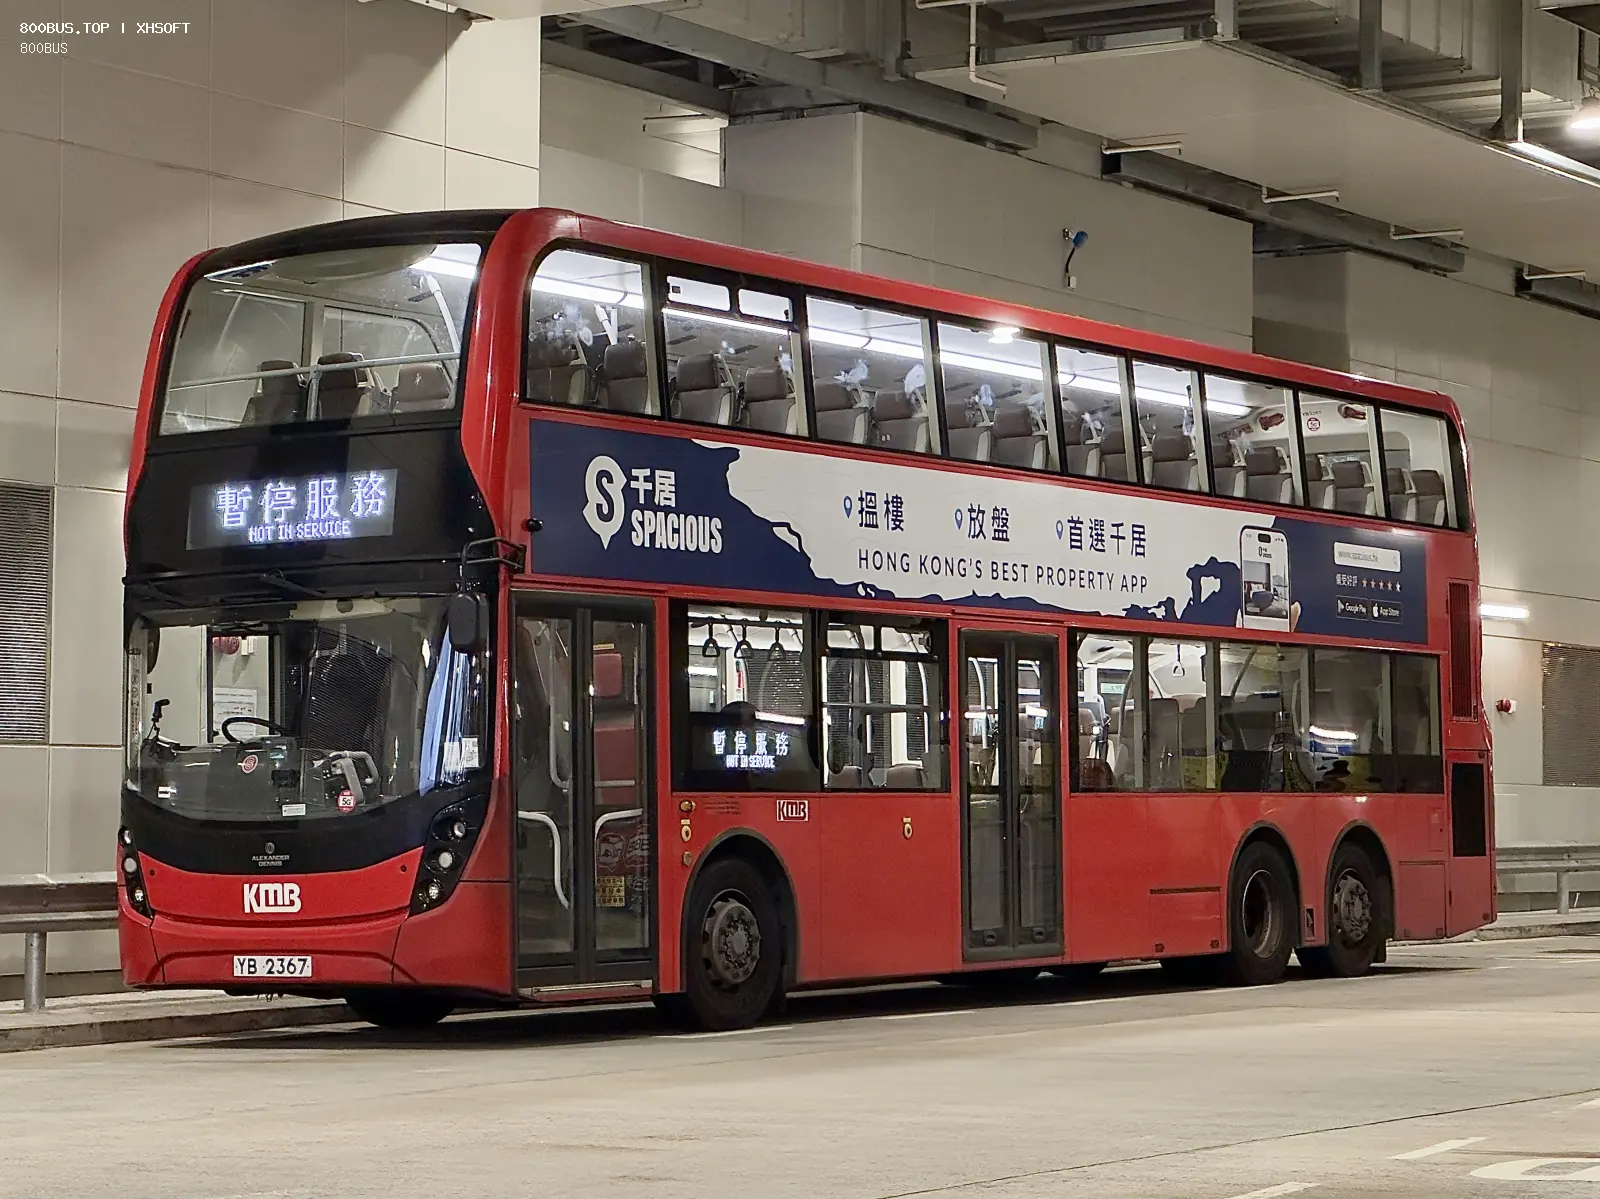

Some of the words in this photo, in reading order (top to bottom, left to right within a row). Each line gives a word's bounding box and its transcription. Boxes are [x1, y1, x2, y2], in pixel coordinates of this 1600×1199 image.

[216, 470, 387, 527] 暫停服務
[630, 468, 676, 508] 千居
[249, 525, 273, 542] NOT
[278, 523, 295, 540] IN
[296, 519, 351, 538] SERVICE
[857, 489, 905, 532] 搵樓
[967, 503, 1011, 543] 放盤
[631, 509, 723, 554] SPACIOUS
[1067, 516, 1147, 558] 首選千居
[858, 548, 911, 573] HONG
[919, 554, 983, 579] KONG'S
[990, 561, 1029, 583] BEST
[1035, 565, 1115, 591] PROPERTY
[1120, 573, 1149, 594] APP
[713, 730, 789, 755] 暫停服務
[748, 755, 776, 769] SERVICE
[237, 957, 257, 975] YB
[265, 957, 308, 975] 2367
